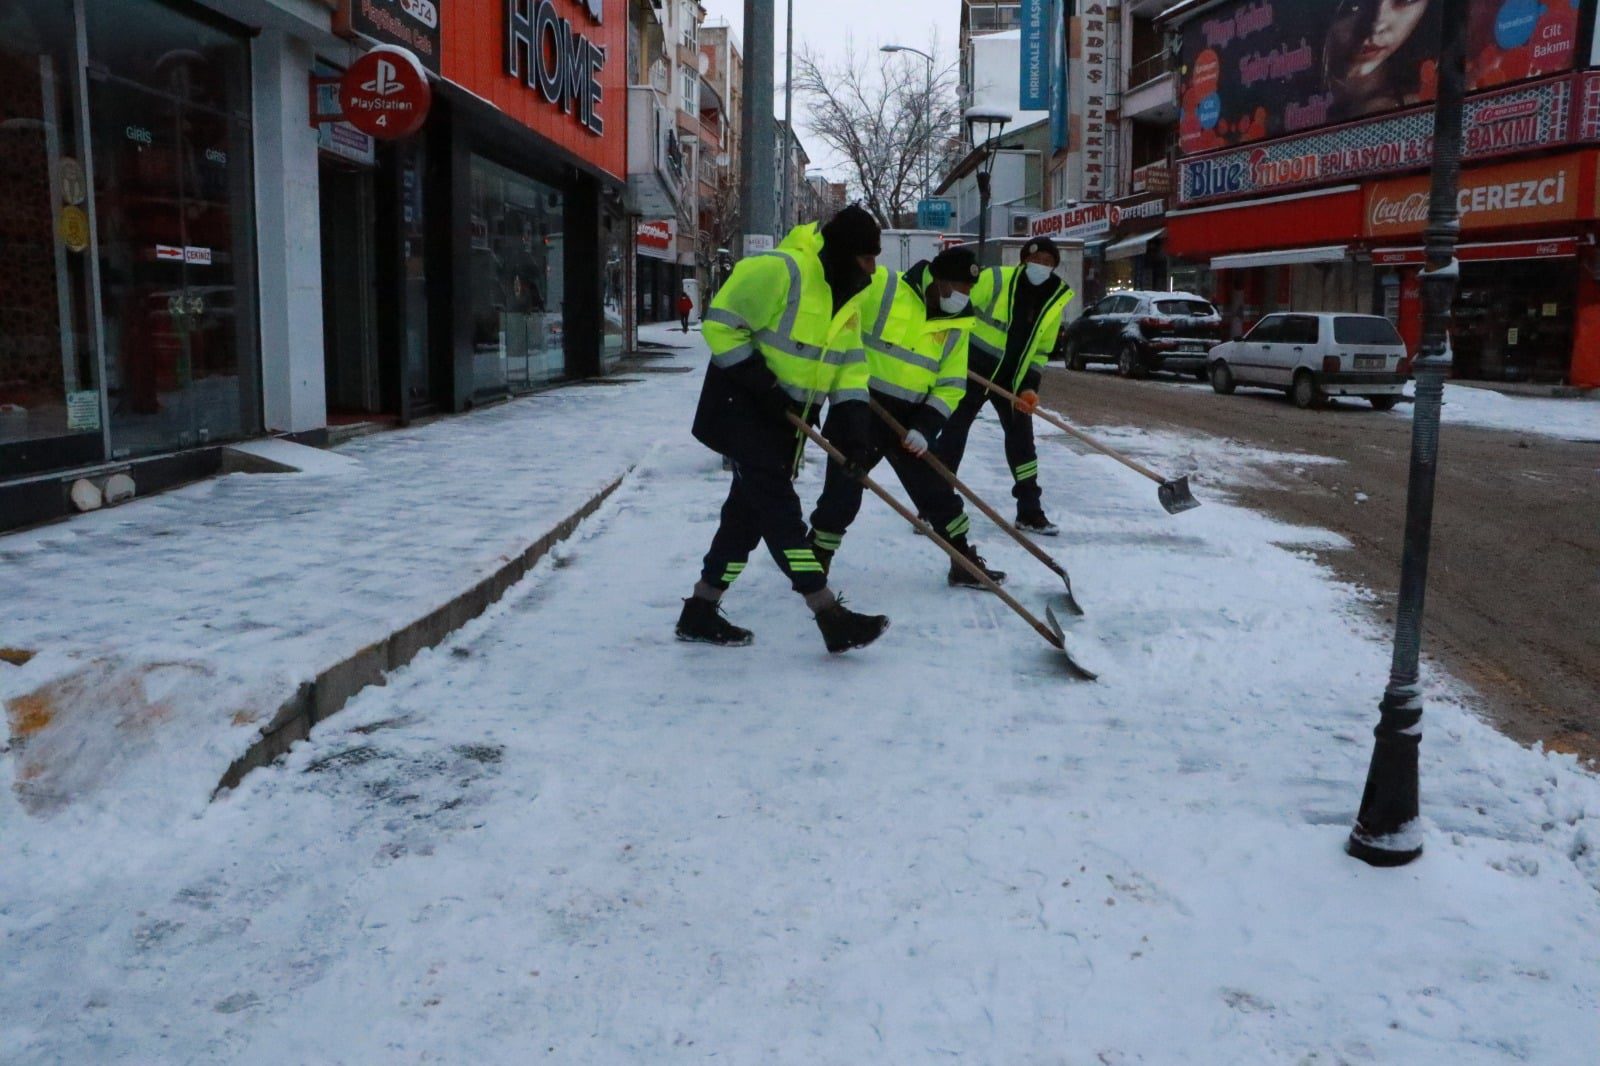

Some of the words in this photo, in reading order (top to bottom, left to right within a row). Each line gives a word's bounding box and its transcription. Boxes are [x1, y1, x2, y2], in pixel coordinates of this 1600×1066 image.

[1542, 23, 1562, 39] Cilt
[1533, 40, 1570, 58] Bakımı
[509, 0, 604, 137] HOME
[1030, 42, 1040, 98] KIRIKKALE
[351, 97, 412, 110] PlayStation
[376, 115, 387, 127] 4
[1086, 96, 1102, 199] ELEKTRİK
[1190, 160, 1242, 198] Blue
[1257, 155, 1318, 185] moon
[1466, 115, 1538, 150] BAKIMI
[1456, 170, 1566, 218] ÇEREZCİ
[1031, 214, 1062, 236] KARDEŞ
